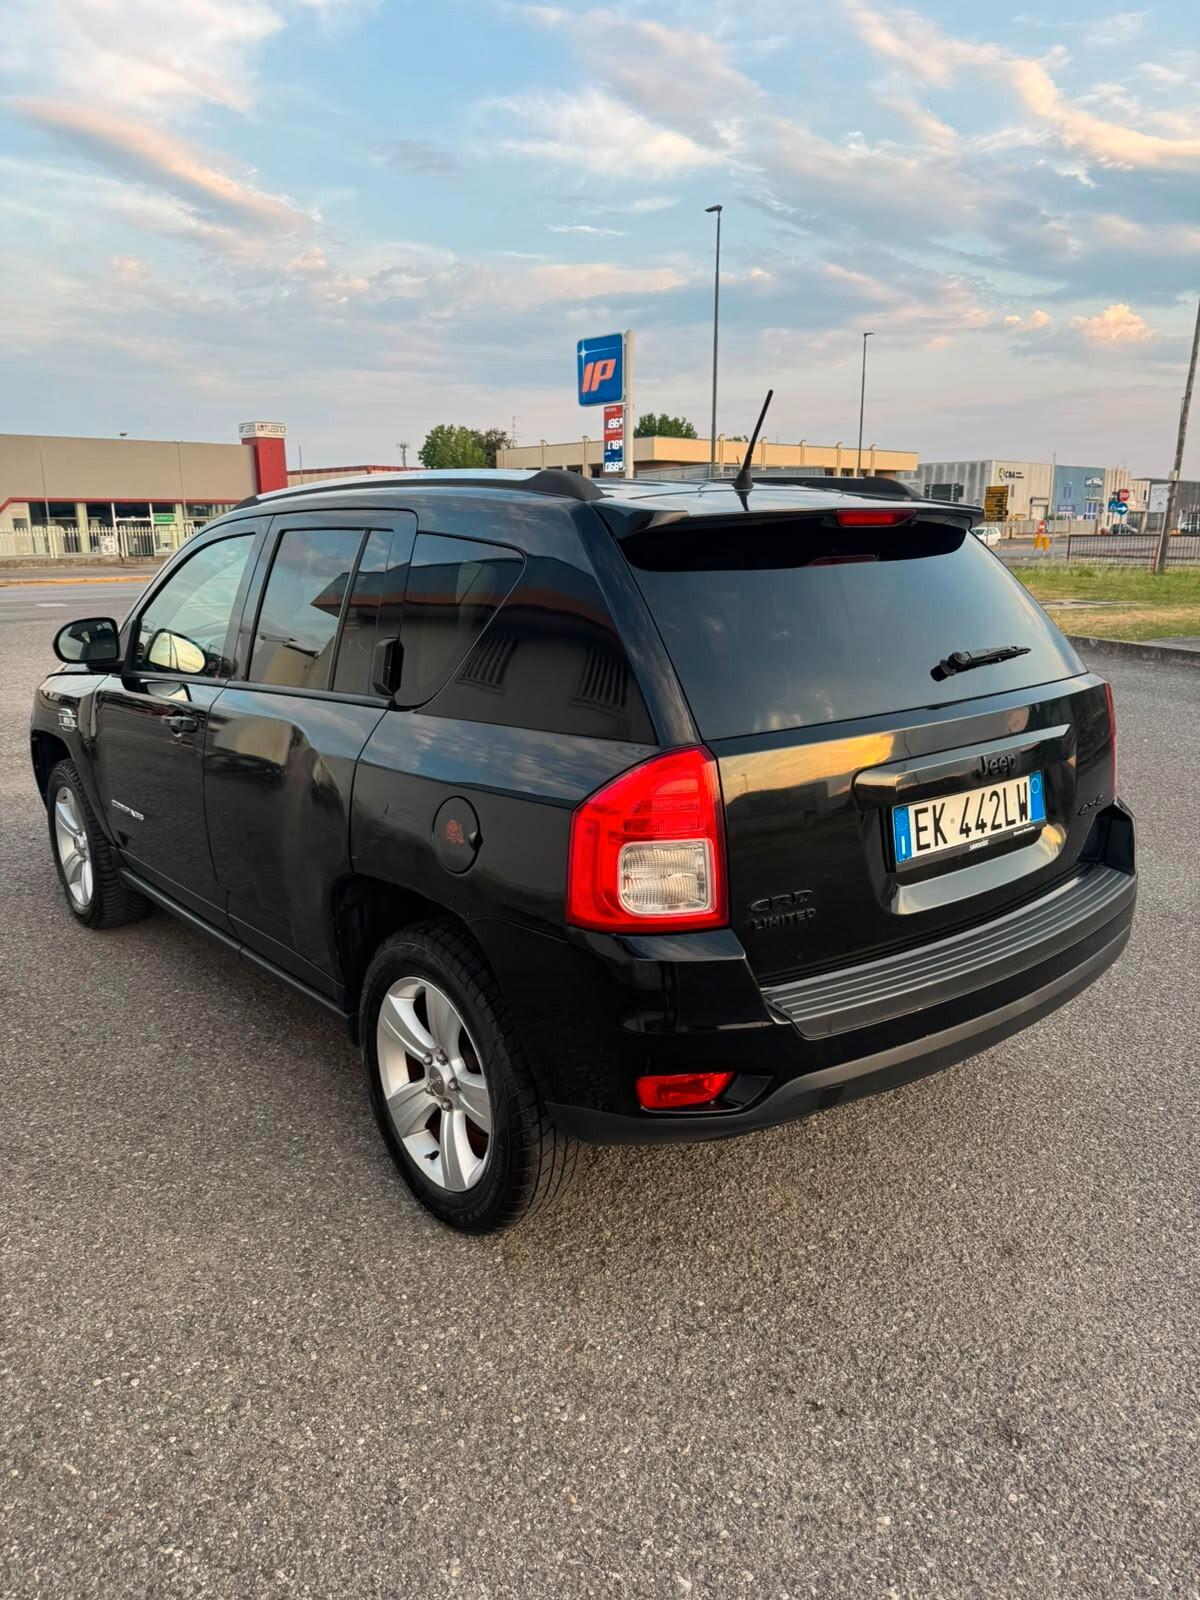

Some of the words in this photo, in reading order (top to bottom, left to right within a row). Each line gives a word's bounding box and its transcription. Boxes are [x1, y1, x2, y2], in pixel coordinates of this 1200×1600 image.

[582, 358, 616, 393] IP
[977, 753, 1016, 777] Jeep
[914, 803, 948, 852] EK
[959, 782, 1029, 839] 442LW
